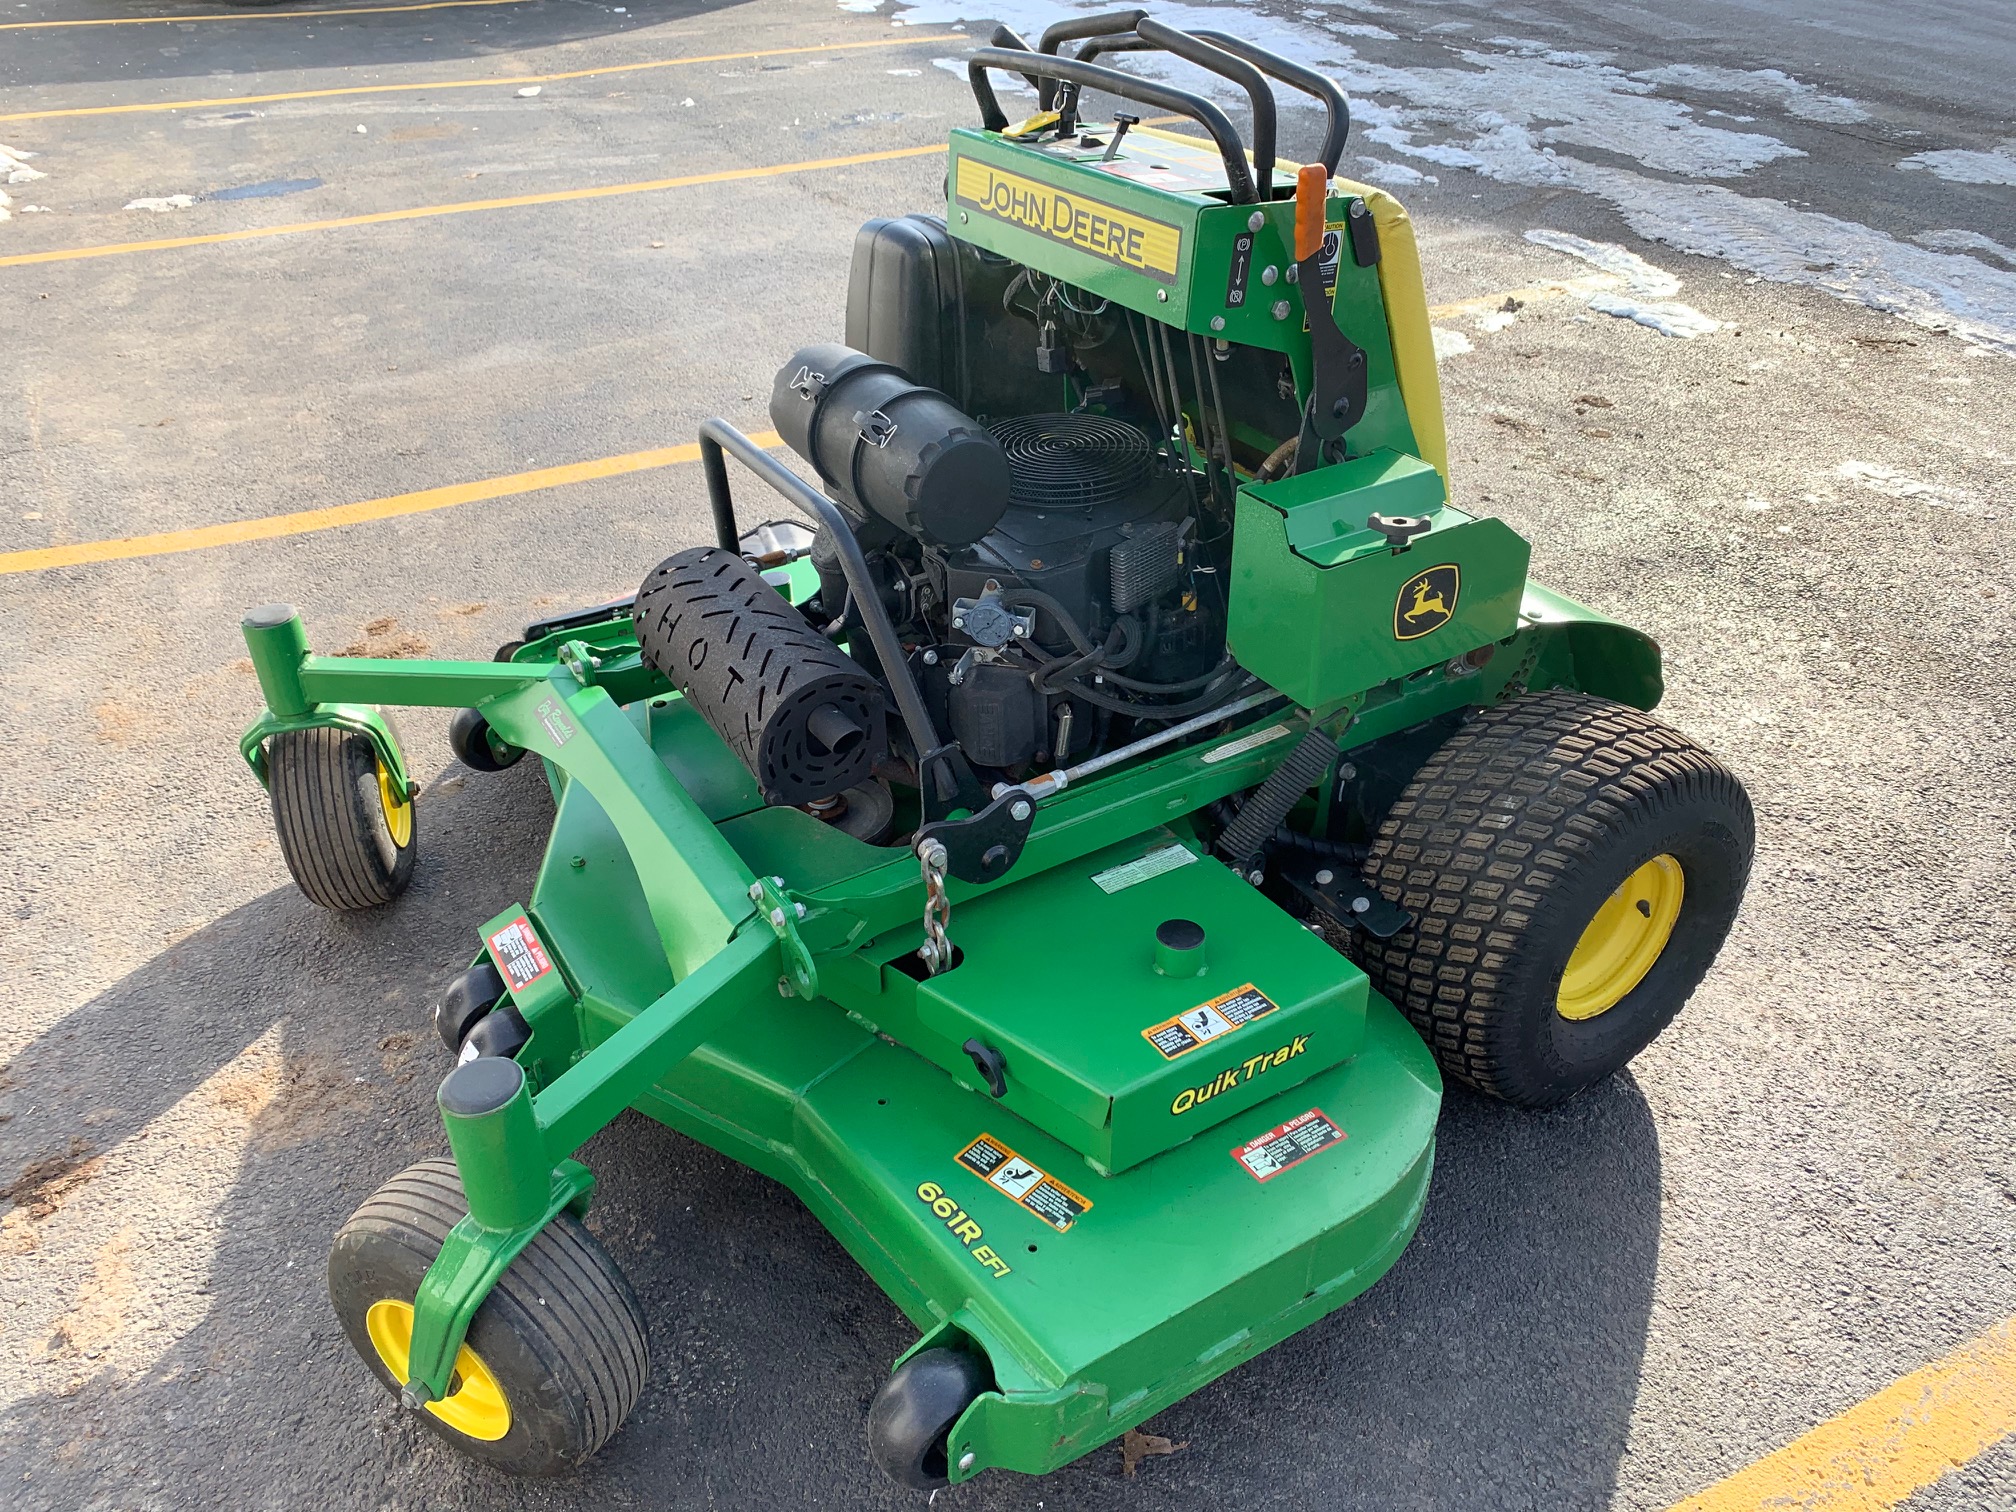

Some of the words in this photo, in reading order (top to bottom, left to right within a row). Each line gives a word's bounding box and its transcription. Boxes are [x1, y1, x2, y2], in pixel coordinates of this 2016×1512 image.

[980, 172, 1046, 227] JOHN
[1053, 194, 1145, 263] DEERE
[1171, 1033, 1313, 1115] QuikTrak
[1249, 1131, 1276, 1148] DANGER
[1288, 1111, 1316, 1129] PELIGRO
[917, 1181, 983, 1247] 661R
[971, 1244, 1012, 1278] EFI
